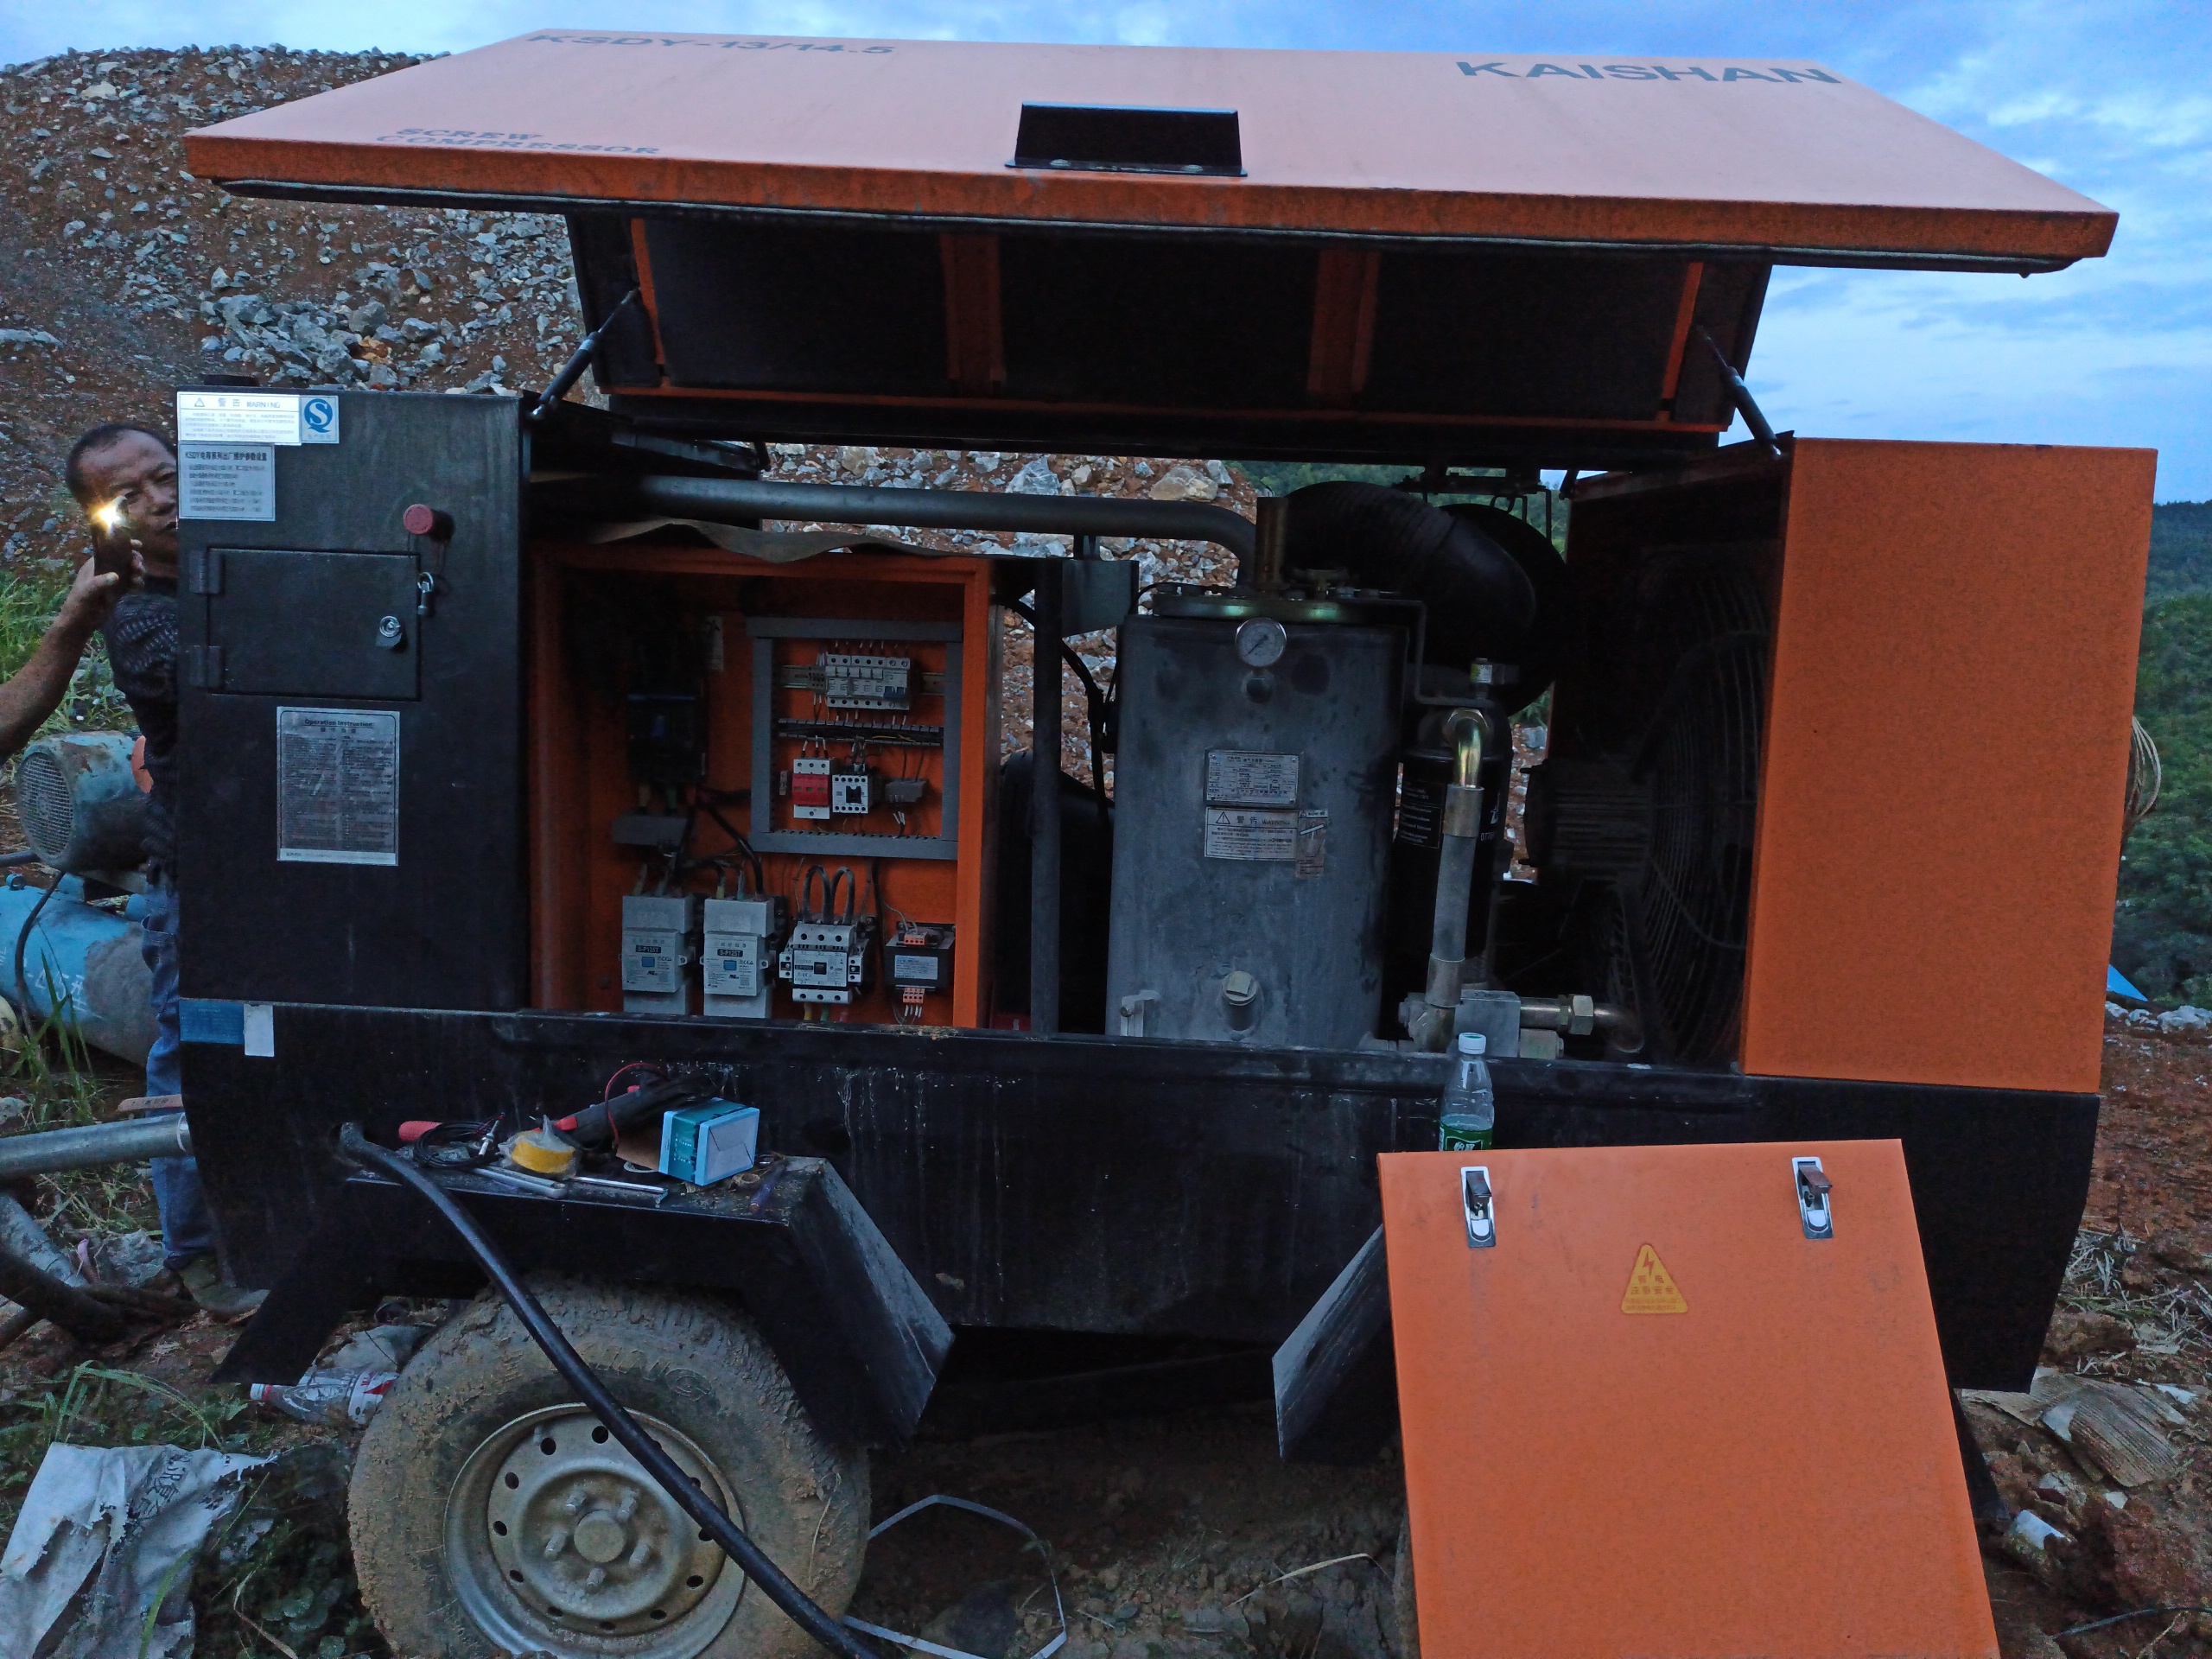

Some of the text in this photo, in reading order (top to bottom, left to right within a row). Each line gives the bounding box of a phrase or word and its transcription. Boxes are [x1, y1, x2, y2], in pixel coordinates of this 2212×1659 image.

[527, 34, 896, 54] KSDY-13/14.5
[1456, 61, 1842, 84] KAISHAN
[396, 127, 543, 141] SCREW
[376, 135, 660, 155] COMPRESSOR
[1236, 815, 1258, 825] 警告
